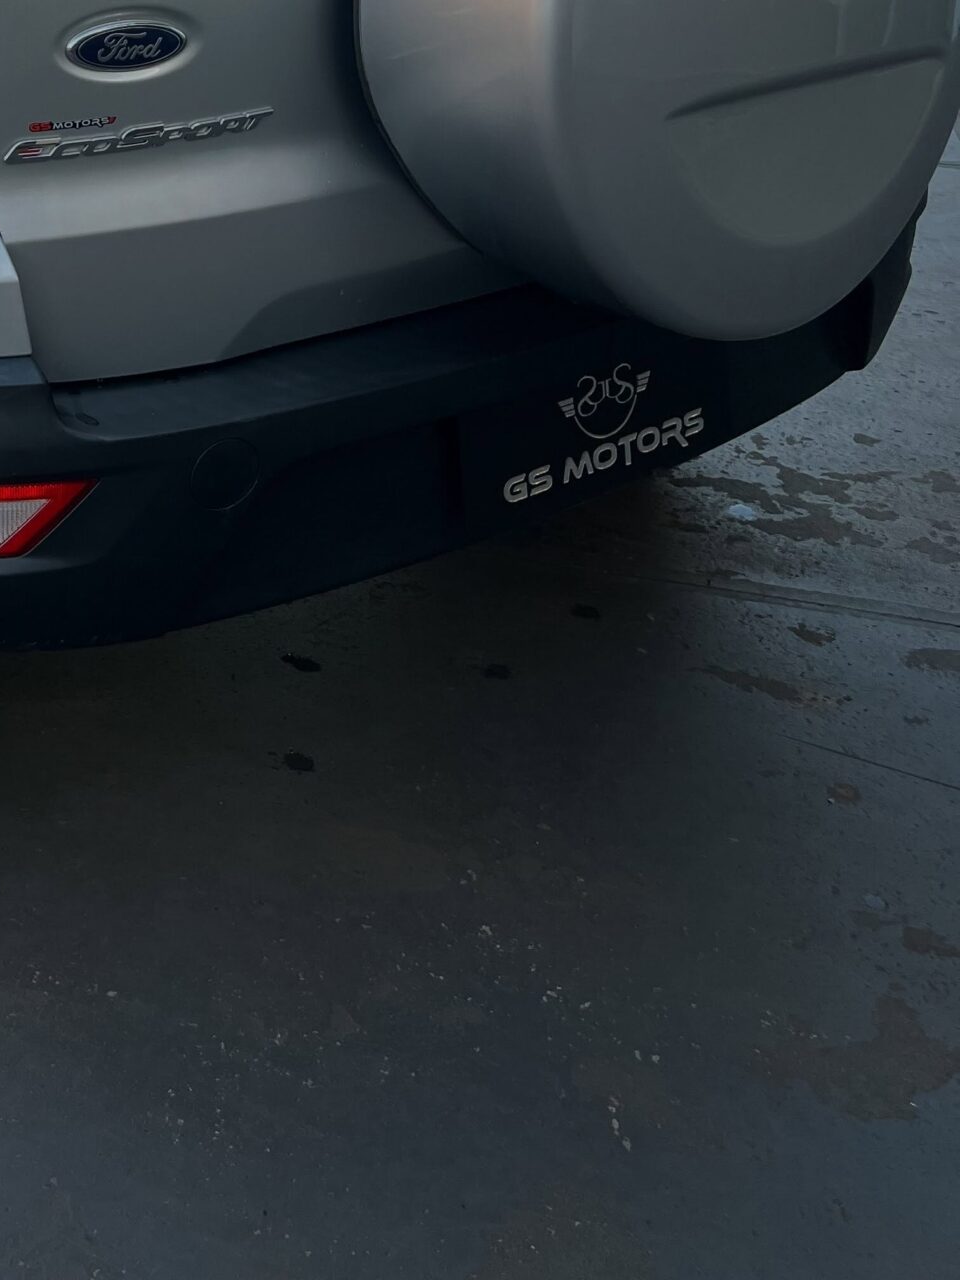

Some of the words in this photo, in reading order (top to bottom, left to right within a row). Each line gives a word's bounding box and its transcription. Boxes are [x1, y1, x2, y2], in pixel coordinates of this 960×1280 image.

[96, 31, 163, 63] Ford
[502, 464, 553, 503] GS
[563, 407, 705, 484] MOTORS
